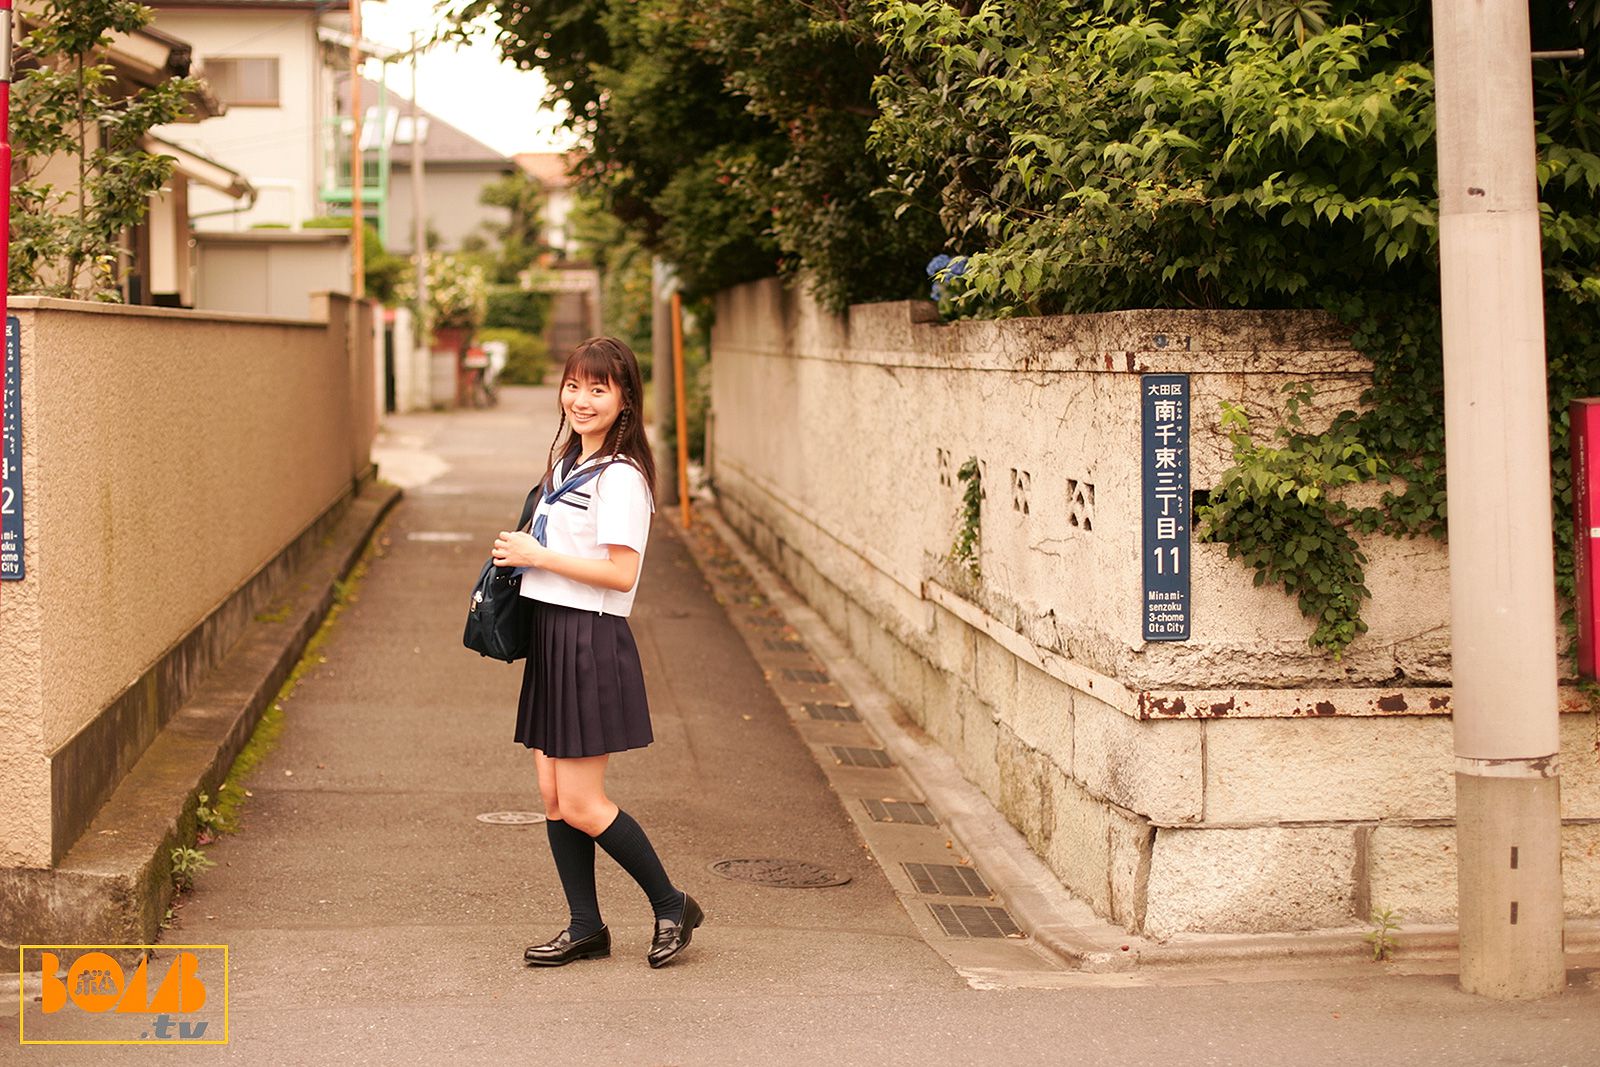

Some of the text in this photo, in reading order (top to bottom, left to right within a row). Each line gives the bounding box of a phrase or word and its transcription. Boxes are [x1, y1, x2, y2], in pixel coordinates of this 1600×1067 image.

[1148, 384, 1182, 396] 大田区
[1154, 399, 1177, 540] 南千束三丁目
[1154, 547, 1179, 574] 11
[1148, 590, 1184, 600] Minami-
[1148, 602, 1182, 612] senzoku
[1148, 613, 1184, 622] 3-chome
[1148, 622, 1184, 633] Ota City
